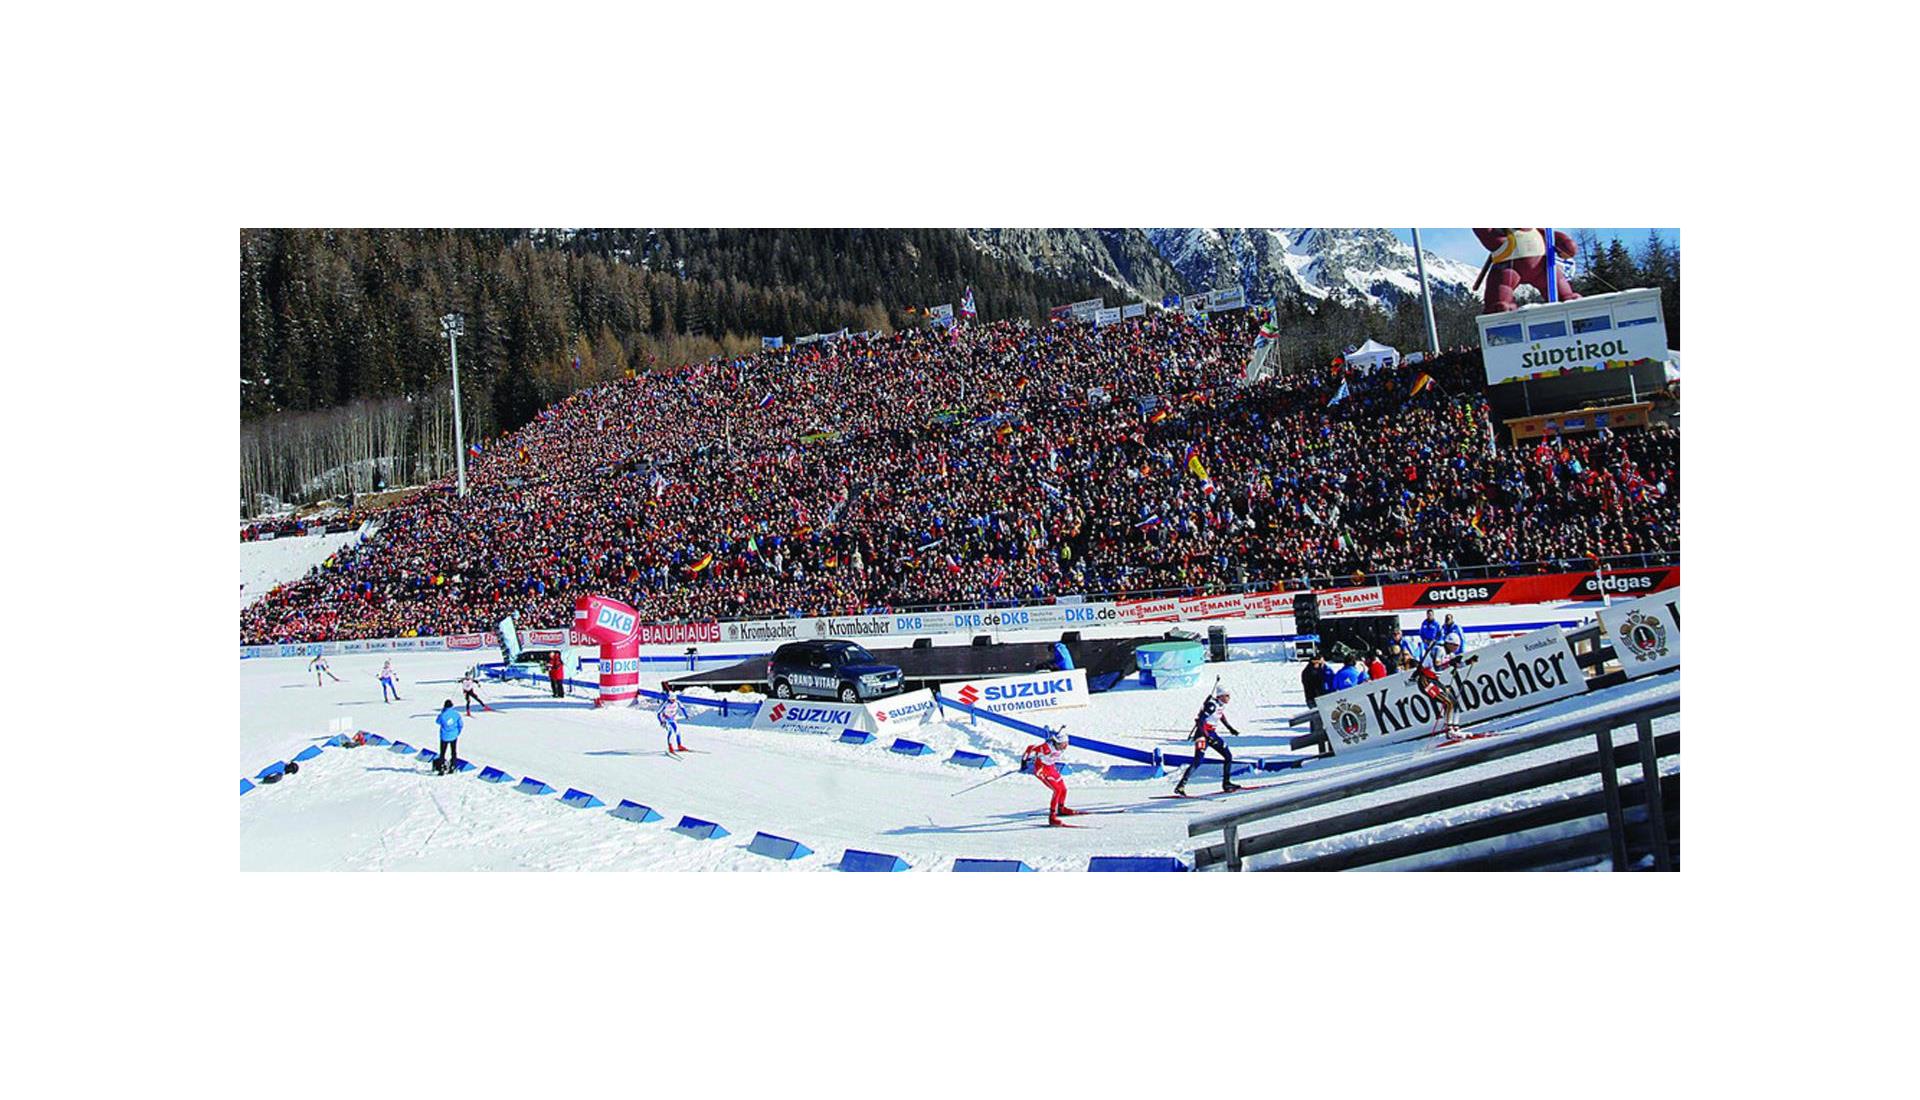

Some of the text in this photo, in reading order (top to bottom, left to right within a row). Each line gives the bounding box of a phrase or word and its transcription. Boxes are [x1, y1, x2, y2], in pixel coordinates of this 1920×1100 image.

[1585, 574, 1652, 592] erdgas
[1429, 585, 1488, 602] erdgas
[598, 608, 632, 632] DKB
[897, 617, 922, 629] DKB
[954, 613, 1000, 627] DKB.de
[1001, 611, 1029, 625] DKB
[1065, 607, 1116, 622] DKB.de
[642, 624, 720, 642] BAUHAUS
[740, 621, 796, 639] Krombacher
[828, 617, 890, 635] Krombacher
[614, 660, 637, 671] DKB
[1143, 653, 1152, 667] 1
[788, 674, 813, 687] GRAND
[984, 678, 1073, 700] SUZUKI
[889, 700, 933, 718] SUZUKI
[987, 697, 1057, 713] AUTOMOBILE
[786, 707, 852, 724] SUZUKI
